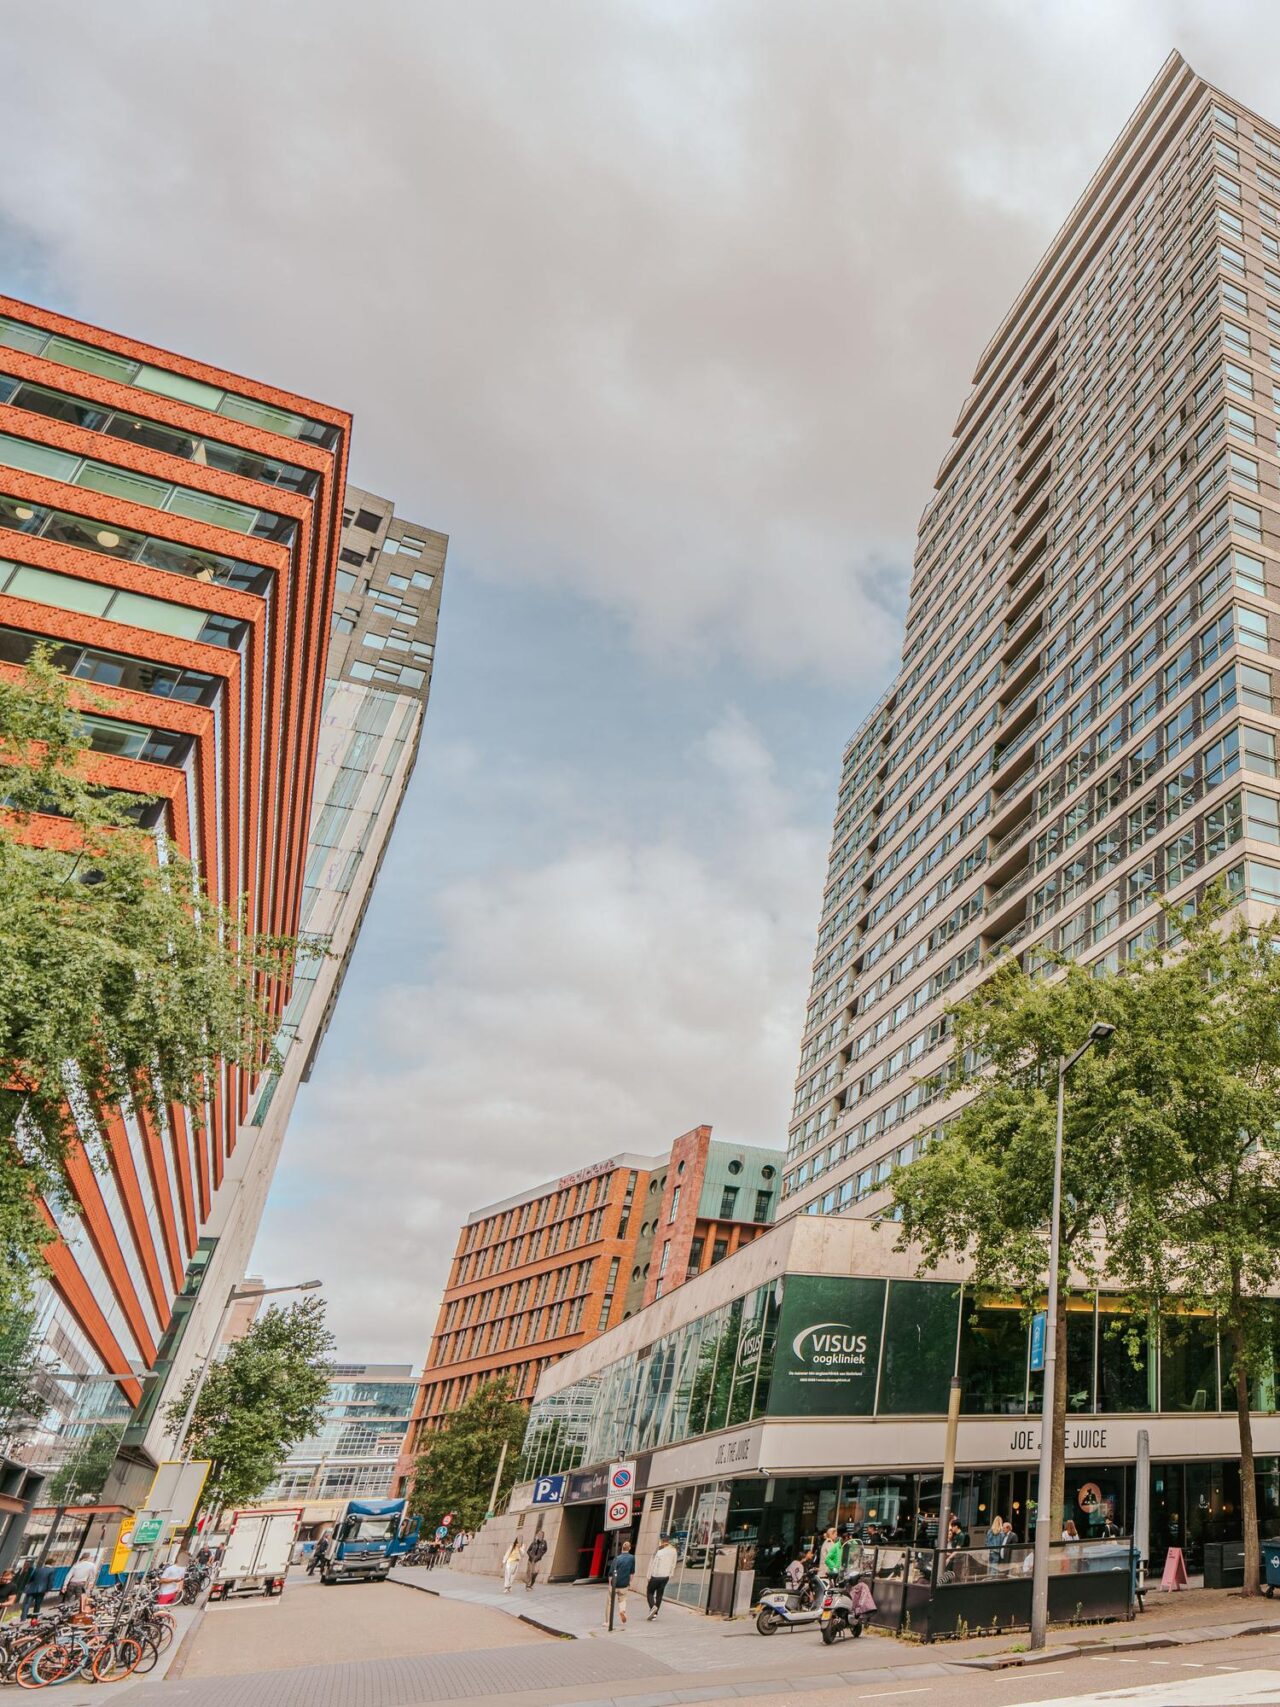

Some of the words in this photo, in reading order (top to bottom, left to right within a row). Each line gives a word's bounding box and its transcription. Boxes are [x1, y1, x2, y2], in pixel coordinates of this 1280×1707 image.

[812, 1334, 867, 1353] VISUS
[812, 1353, 866, 1365] oogkliniek
[1010, 1431, 1034, 1450] JOE
[1073, 1429, 1107, 1449] JUICE
[536, 1481, 551, 1501] P
[613, 1507, 625, 1517] 30
